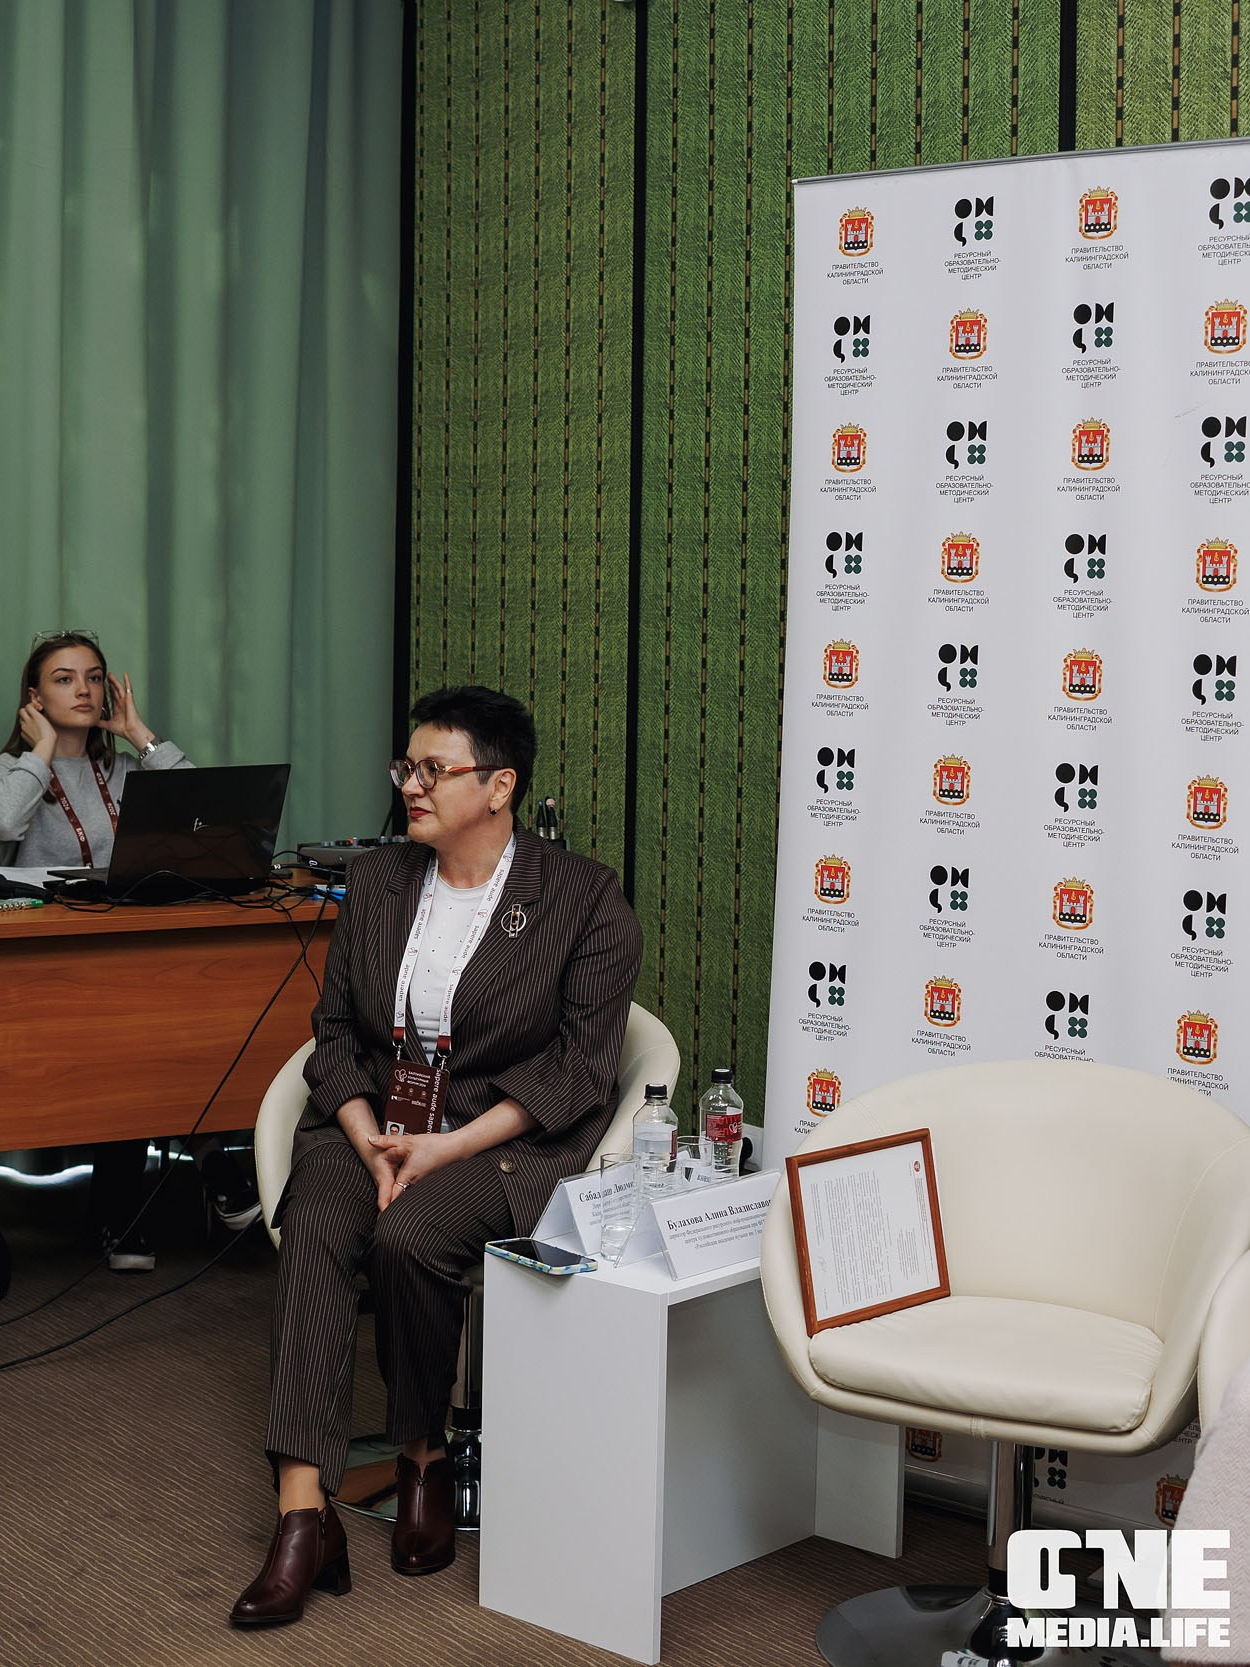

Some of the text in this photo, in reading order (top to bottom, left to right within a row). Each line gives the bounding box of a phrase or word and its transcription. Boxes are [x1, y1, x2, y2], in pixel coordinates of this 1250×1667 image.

[954, 250, 991, 258] РЕСУРСНЫЙ
[1072, 245, 1123, 254] ПРАВИТЕЛЬСТВО
[1066, 252, 1128, 262] КАЛИНИНГРАДСКОЙ
[832, 262, 878, 270] ПРАВИТЕЛЬСТВО
[944, 258, 1000, 267] ОБРАЗОВАТЕЛЬНО-
[827, 268, 883, 278] КАЛИНИНГРАДСКОЙ
[937, 373, 997, 381] КАЛИНИНГРАДСКОЙ
[1066, 373, 1116, 381] МЕТОДИЧЕСКИЙ
[828, 381, 872, 389] МЕТОДИЧЕСКИЙ
[816, 694, 864, 702] ПРАВИТЕЛЬСТВО
[812, 702, 868, 710] КАЛИНИНГРАДСКОЙ
[928, 704, 984, 712] ОБРАЗОВАТЕЛЬНО-
[1054, 707, 1107, 715] ПРАВИТЕЛЬСТВО
[1192, 711, 1233, 719] РЕСУРСНЫЙ
[1048, 715, 1112, 723] КАЛИНИНГРАДСКОЙ
[1181, 718, 1244, 727] ОБРАЗОВАТЕЛЬНО-
[1186, 726, 1238, 735] МЕТОДИЧЕСКИЙ
[807, 805, 861, 814] ОБРАЗОВАТЕЛЬНО-
[811, 812, 856, 821] МЕТОДИЧЕСКИЙ
[926, 810, 975, 820] ПРАВИТЕЛЬСТВО
[920, 818, 980, 828] КАЛИНИНГРАДСКОЙ
[1055, 818, 1095, 826] РЕСУРСНЫЙ
[1044, 825, 1104, 835] ОБРАЗОВАТЕЛЬНО-
[1048, 833, 1100, 842] МЕТОДИЧЕСКИЙ
[1178, 834, 1233, 844] ПРАВИТЕЛЬСТВО
[1172, 842, 1238, 854] КАЛИНИНГРАДСКОЙ
[1191, 852, 1220, 860] ОБЛАСТИ
[808, 908, 855, 918] ПРАВИТЕЛЬСТВО
[803, 916, 859, 926] КАЛИНИНГРАДСКОЙ
[929, 918, 966, 927] РЕСУРСНЫЙ
[919, 925, 975, 936] ОБРАЗОВАТЕЛЬНО-
[923, 932, 970, 942] МЕТОДИЧЕСКИЙ
[1045, 934, 1098, 945] ПРАВИТЕЛЬСТВО
[1039, 942, 1104, 954] КАЛИНИНГРАДСКОЙ
[1182, 946, 1223, 956] РЕСУРСНЫЙ
[1057, 952, 1087, 960] ОБЛАСТИ
[1171, 953, 1233, 965] ОБРАЗОВАТЕЛЬНО-
[1175, 961, 1228, 972] МЕТОДИЧЕСКИЙ
[808, 1013, 843, 1022] РЕСУРСНЫЙ
[799, 1018, 851, 1030] ОБРАЗОВАТЕЛЬНО-
[802, 1026, 847, 1037] МЕТОДИЧЕСКИЙ
[917, 1030, 966, 1042] ПРАВИТЕЛЬСТВО
[912, 1038, 971, 1050] КАЛИНИНГРАДСКОЙ
[928, 1048, 955, 1056] ОБЛАСТИ
[1044, 1044, 1086, 1056] РЕСУРСНЫЙ
[1168, 1068, 1223, 1081] ПРАВИТЕЛЬСТВО
[704, 1210, 728, 1221] Алина
